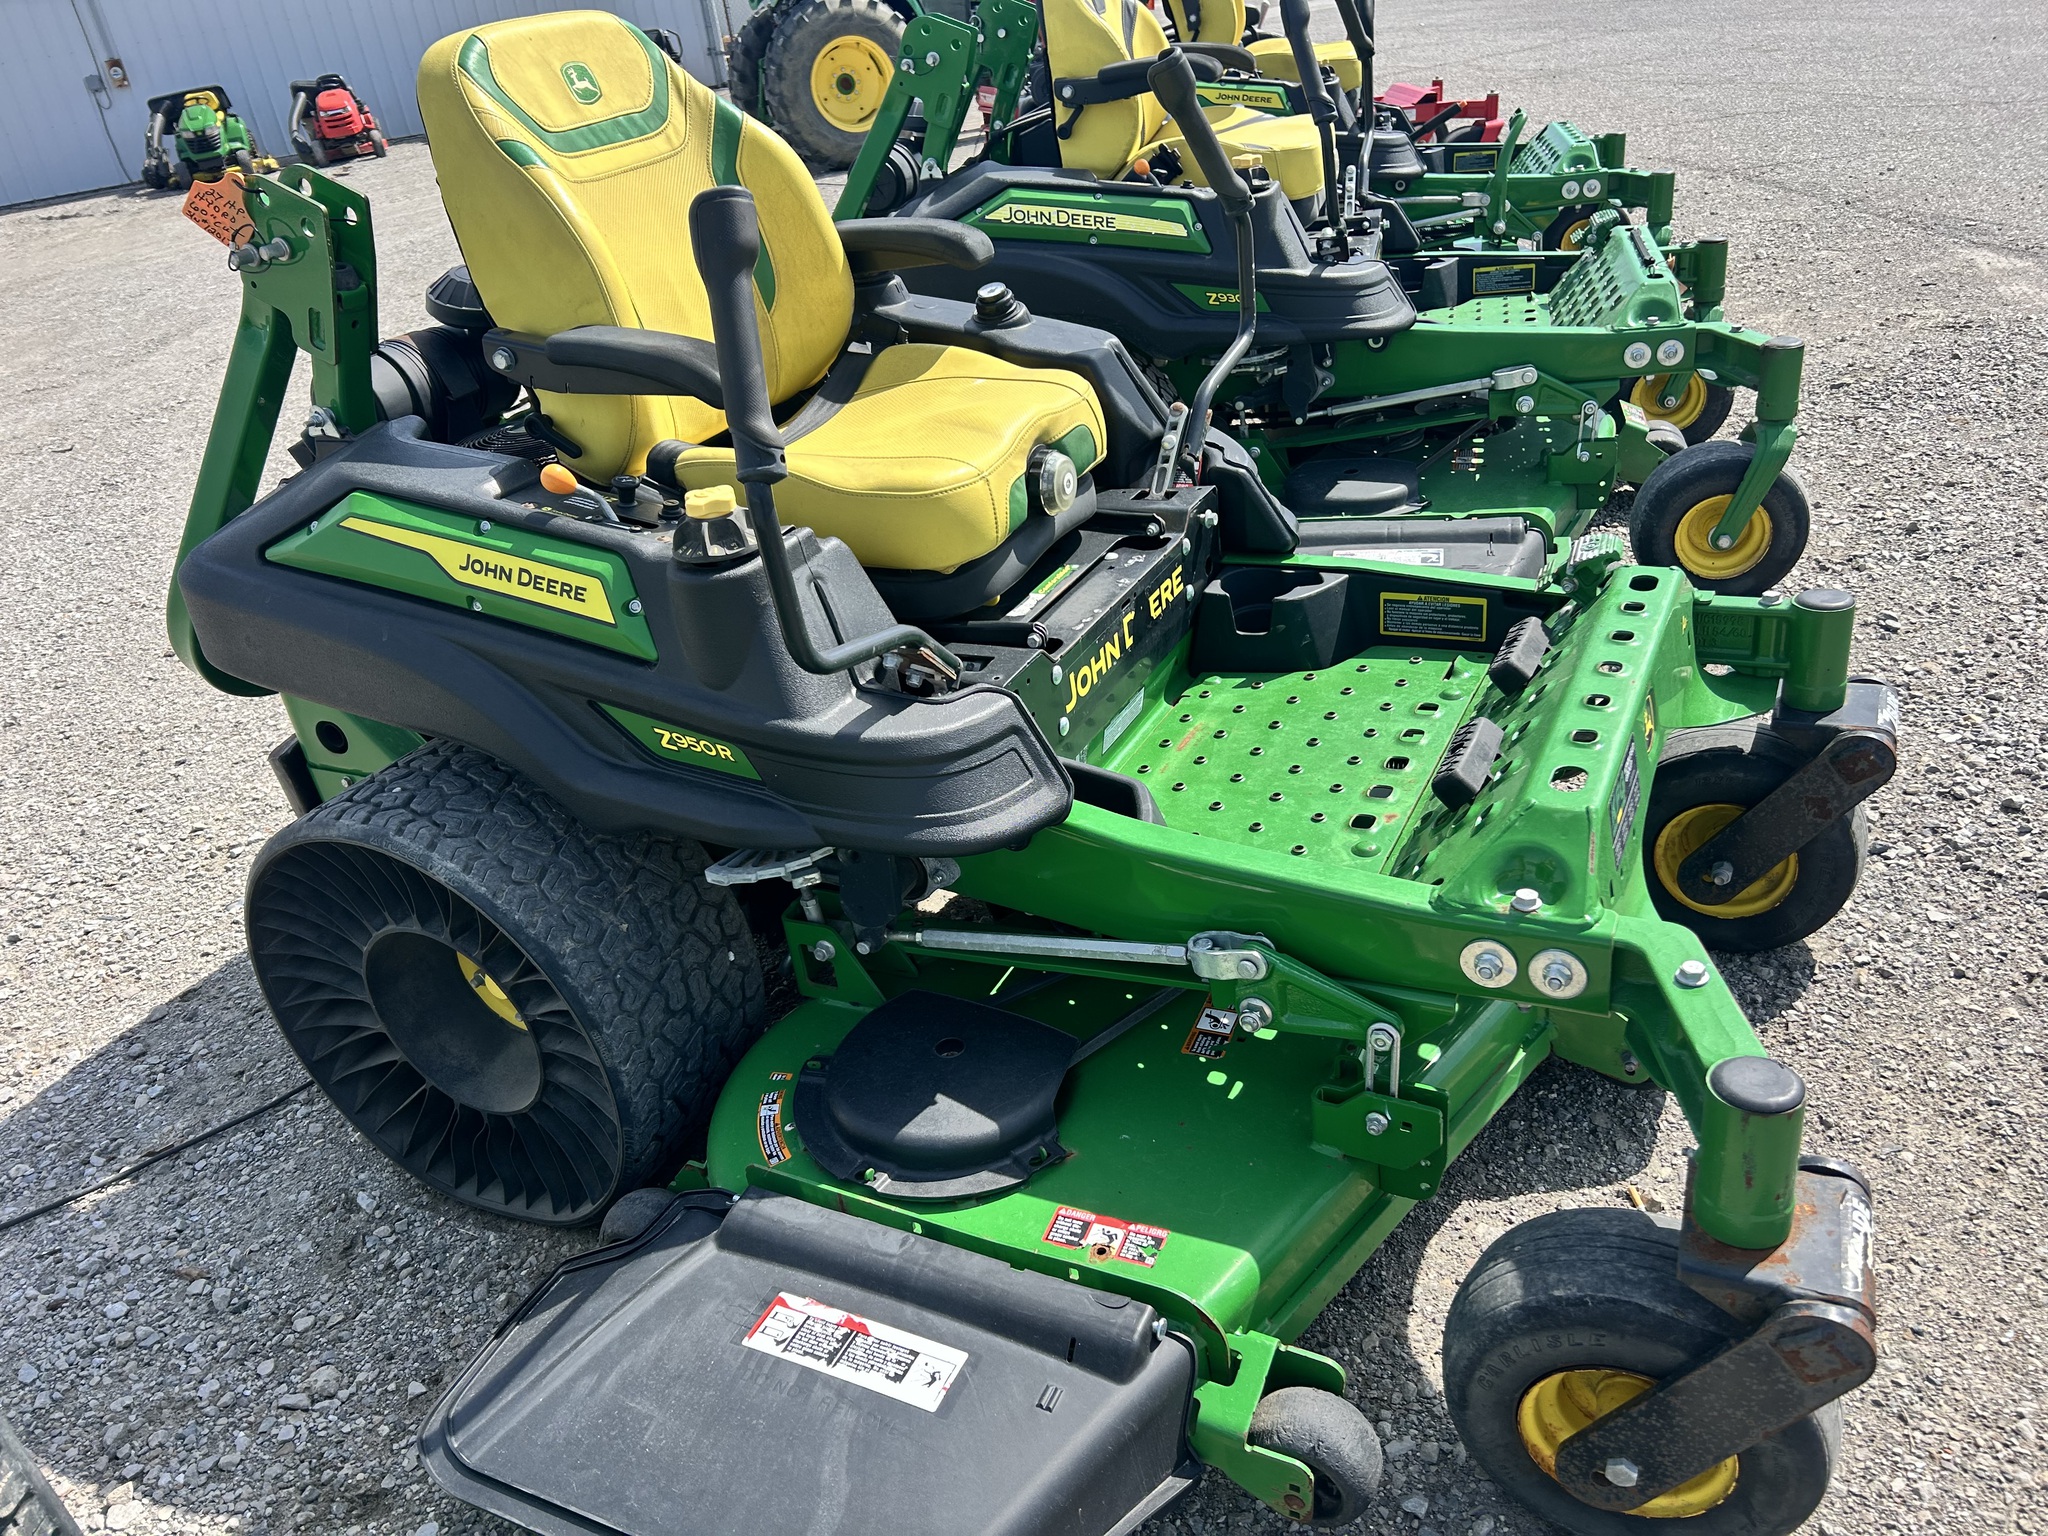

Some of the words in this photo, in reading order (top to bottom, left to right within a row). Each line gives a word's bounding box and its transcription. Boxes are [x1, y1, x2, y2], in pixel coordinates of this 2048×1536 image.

[1215, 92, 1240, 102] JOHN
[1242, 94, 1273, 104] DEERE
[204, 188, 224, 201] 27
[1002, 206, 1052, 223] JOHN
[1056, 209, 1117, 229] DEERE
[458, 553, 513, 584] JOHN
[517, 567, 588, 603] DEERE
[1065, 631, 1121, 714] JOHN
[652, 726, 736, 762] Z950R
[1066, 1209, 1096, 1222] DANGER
[1476, 1333, 1607, 1391] CARLISLE
